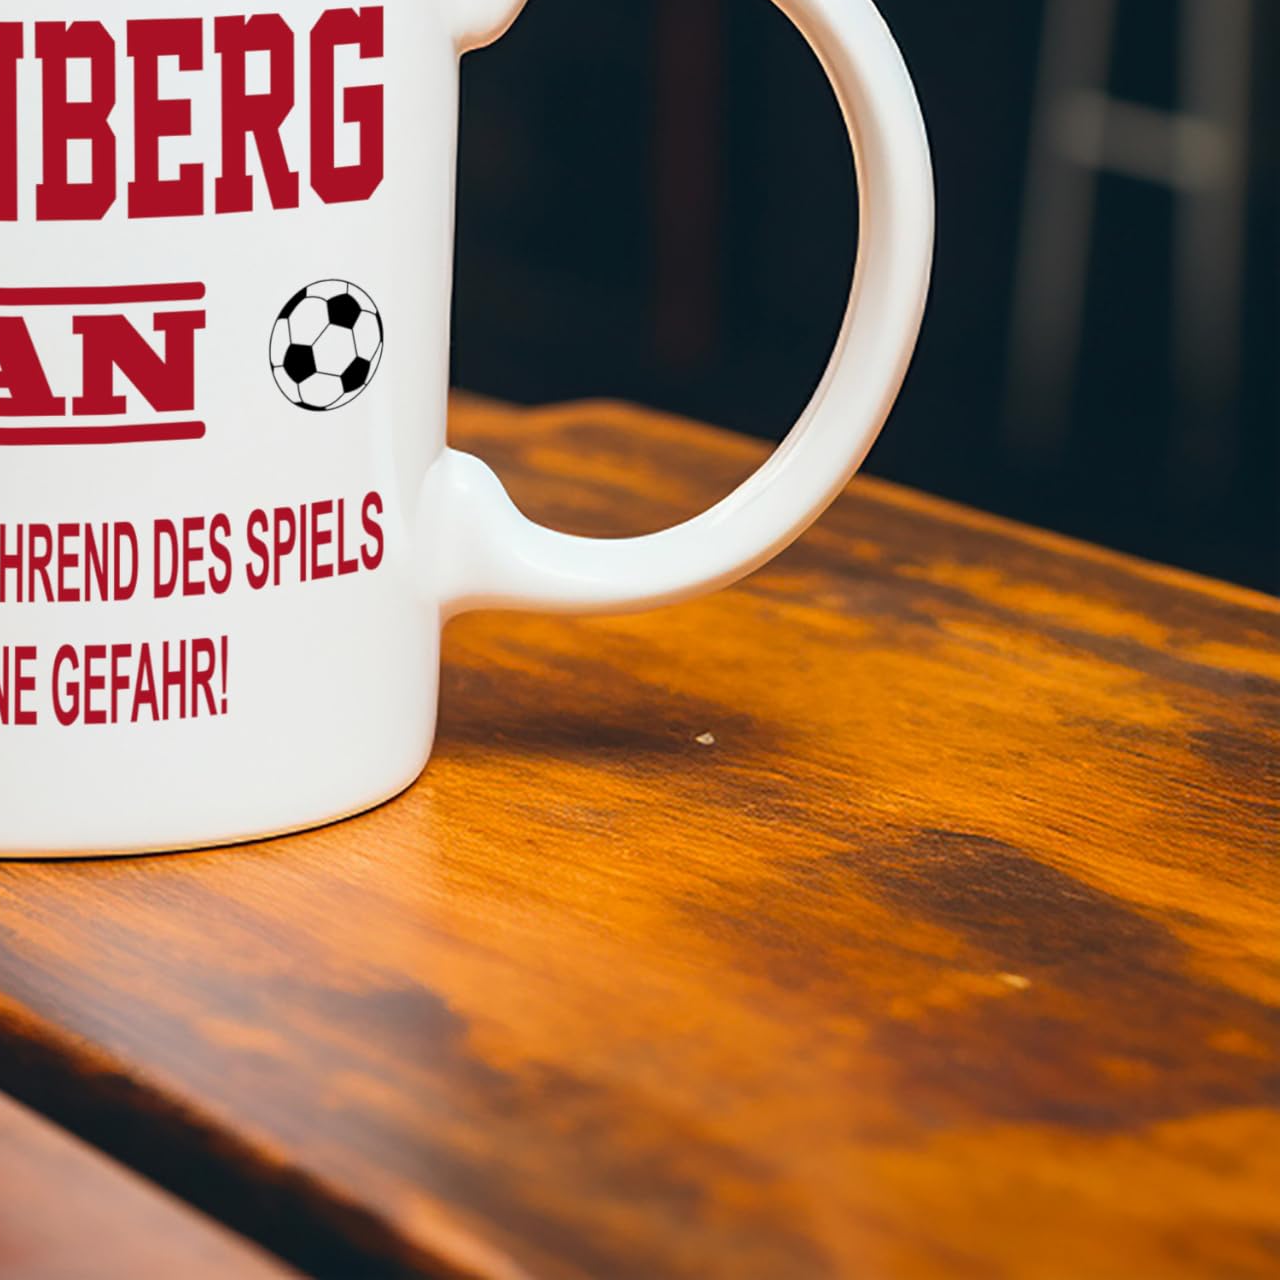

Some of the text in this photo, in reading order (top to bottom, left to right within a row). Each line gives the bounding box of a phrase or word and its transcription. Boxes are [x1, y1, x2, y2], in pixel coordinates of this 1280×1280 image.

[153, 513, 233, 599] DES
[245, 491, 384, 590] SPIELS
[51, 635, 228, 726] GEFAHR!
